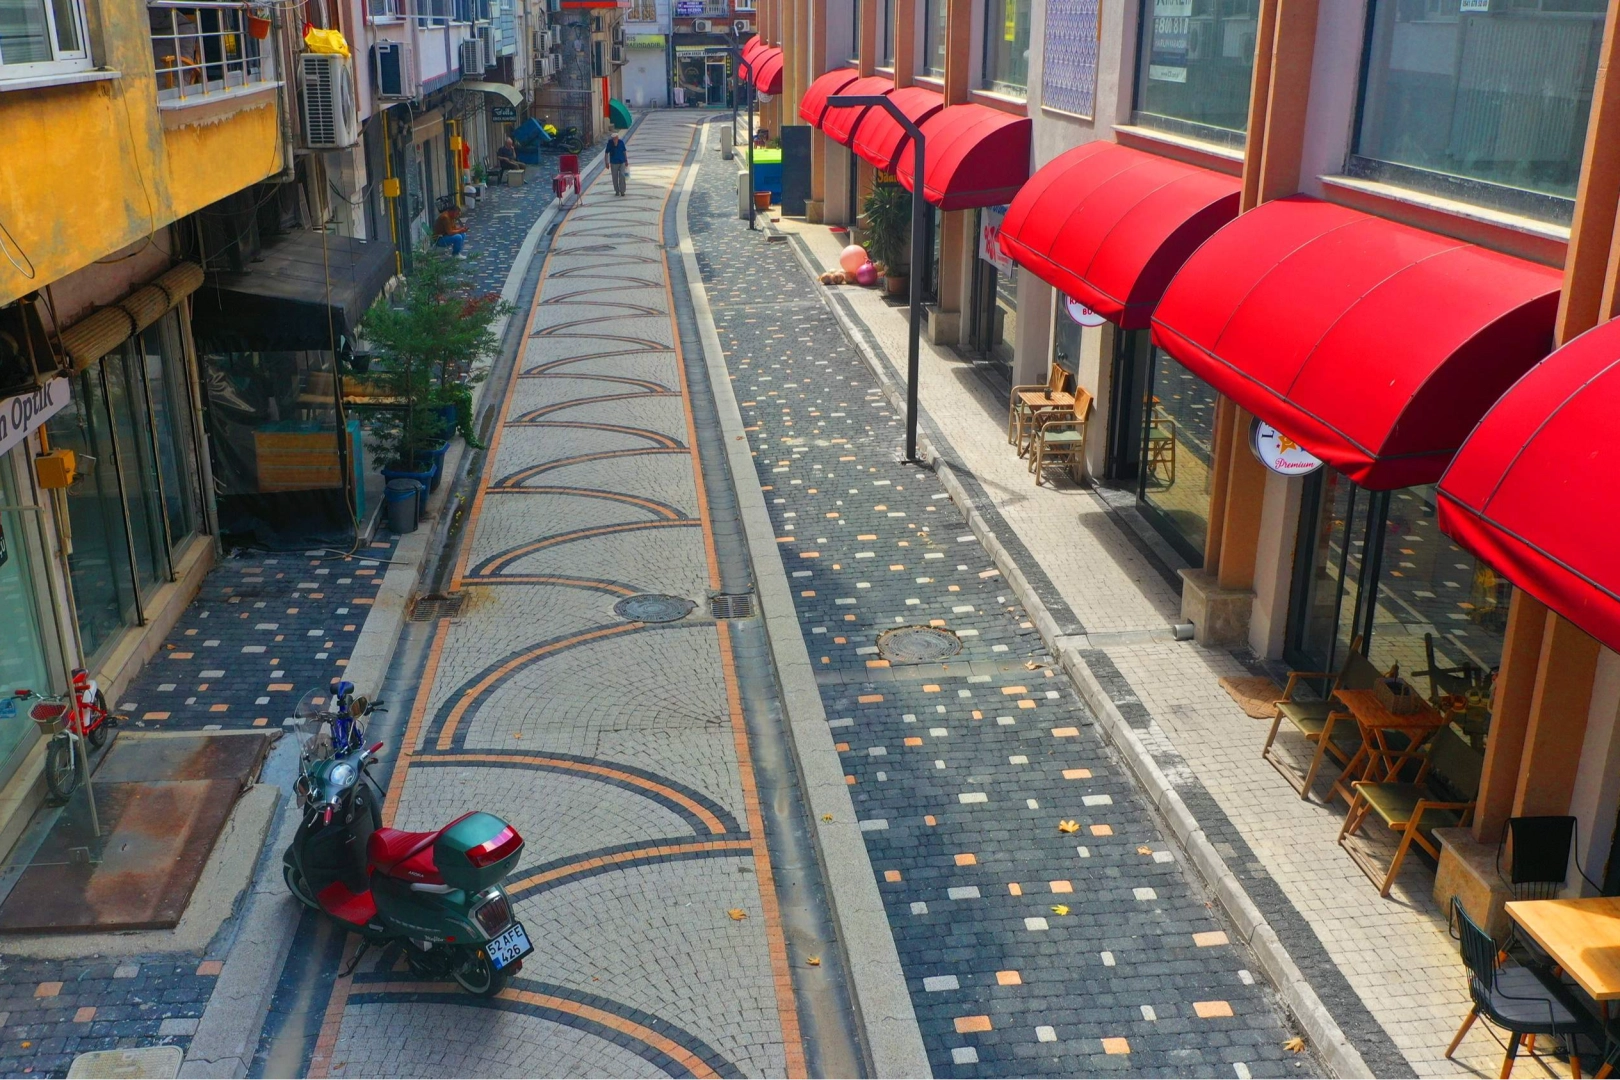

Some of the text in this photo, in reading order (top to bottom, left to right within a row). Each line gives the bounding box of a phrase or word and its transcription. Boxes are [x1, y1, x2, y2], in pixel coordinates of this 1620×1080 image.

[11, 381, 54, 433] Optik
[1275, 458, 1315, 469] Premium
[487, 925, 523, 955] 52 AFE
[501, 944, 521, 963] 426
